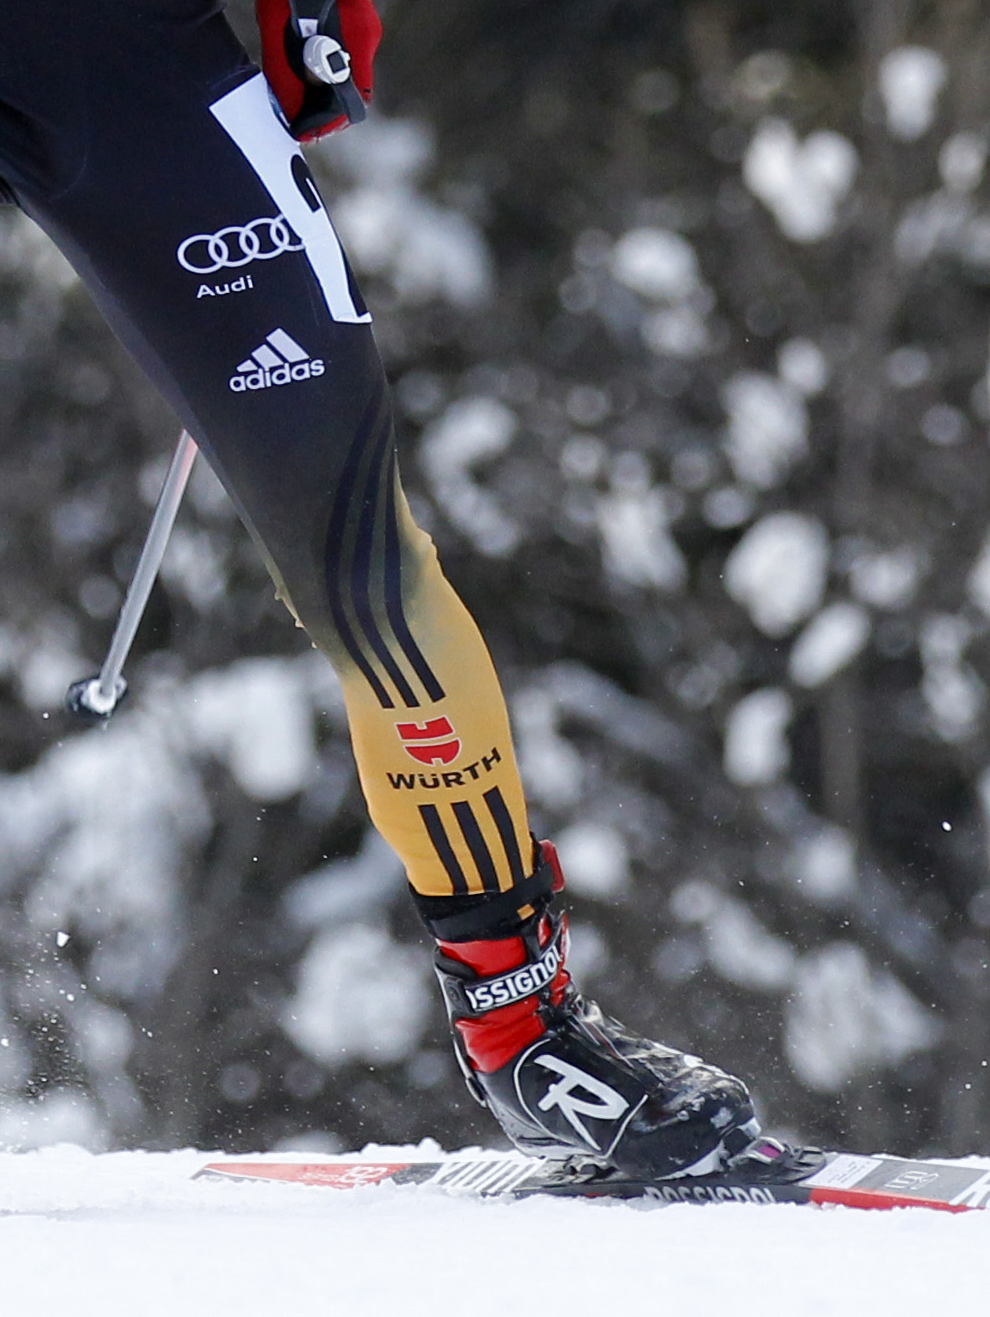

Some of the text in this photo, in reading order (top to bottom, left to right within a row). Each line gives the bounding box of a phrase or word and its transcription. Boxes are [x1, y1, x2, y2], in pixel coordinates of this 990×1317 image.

[196, 275, 254, 298] Audi
[229, 358, 326, 392] adidas
[386, 747, 502, 790] WÜRTH
